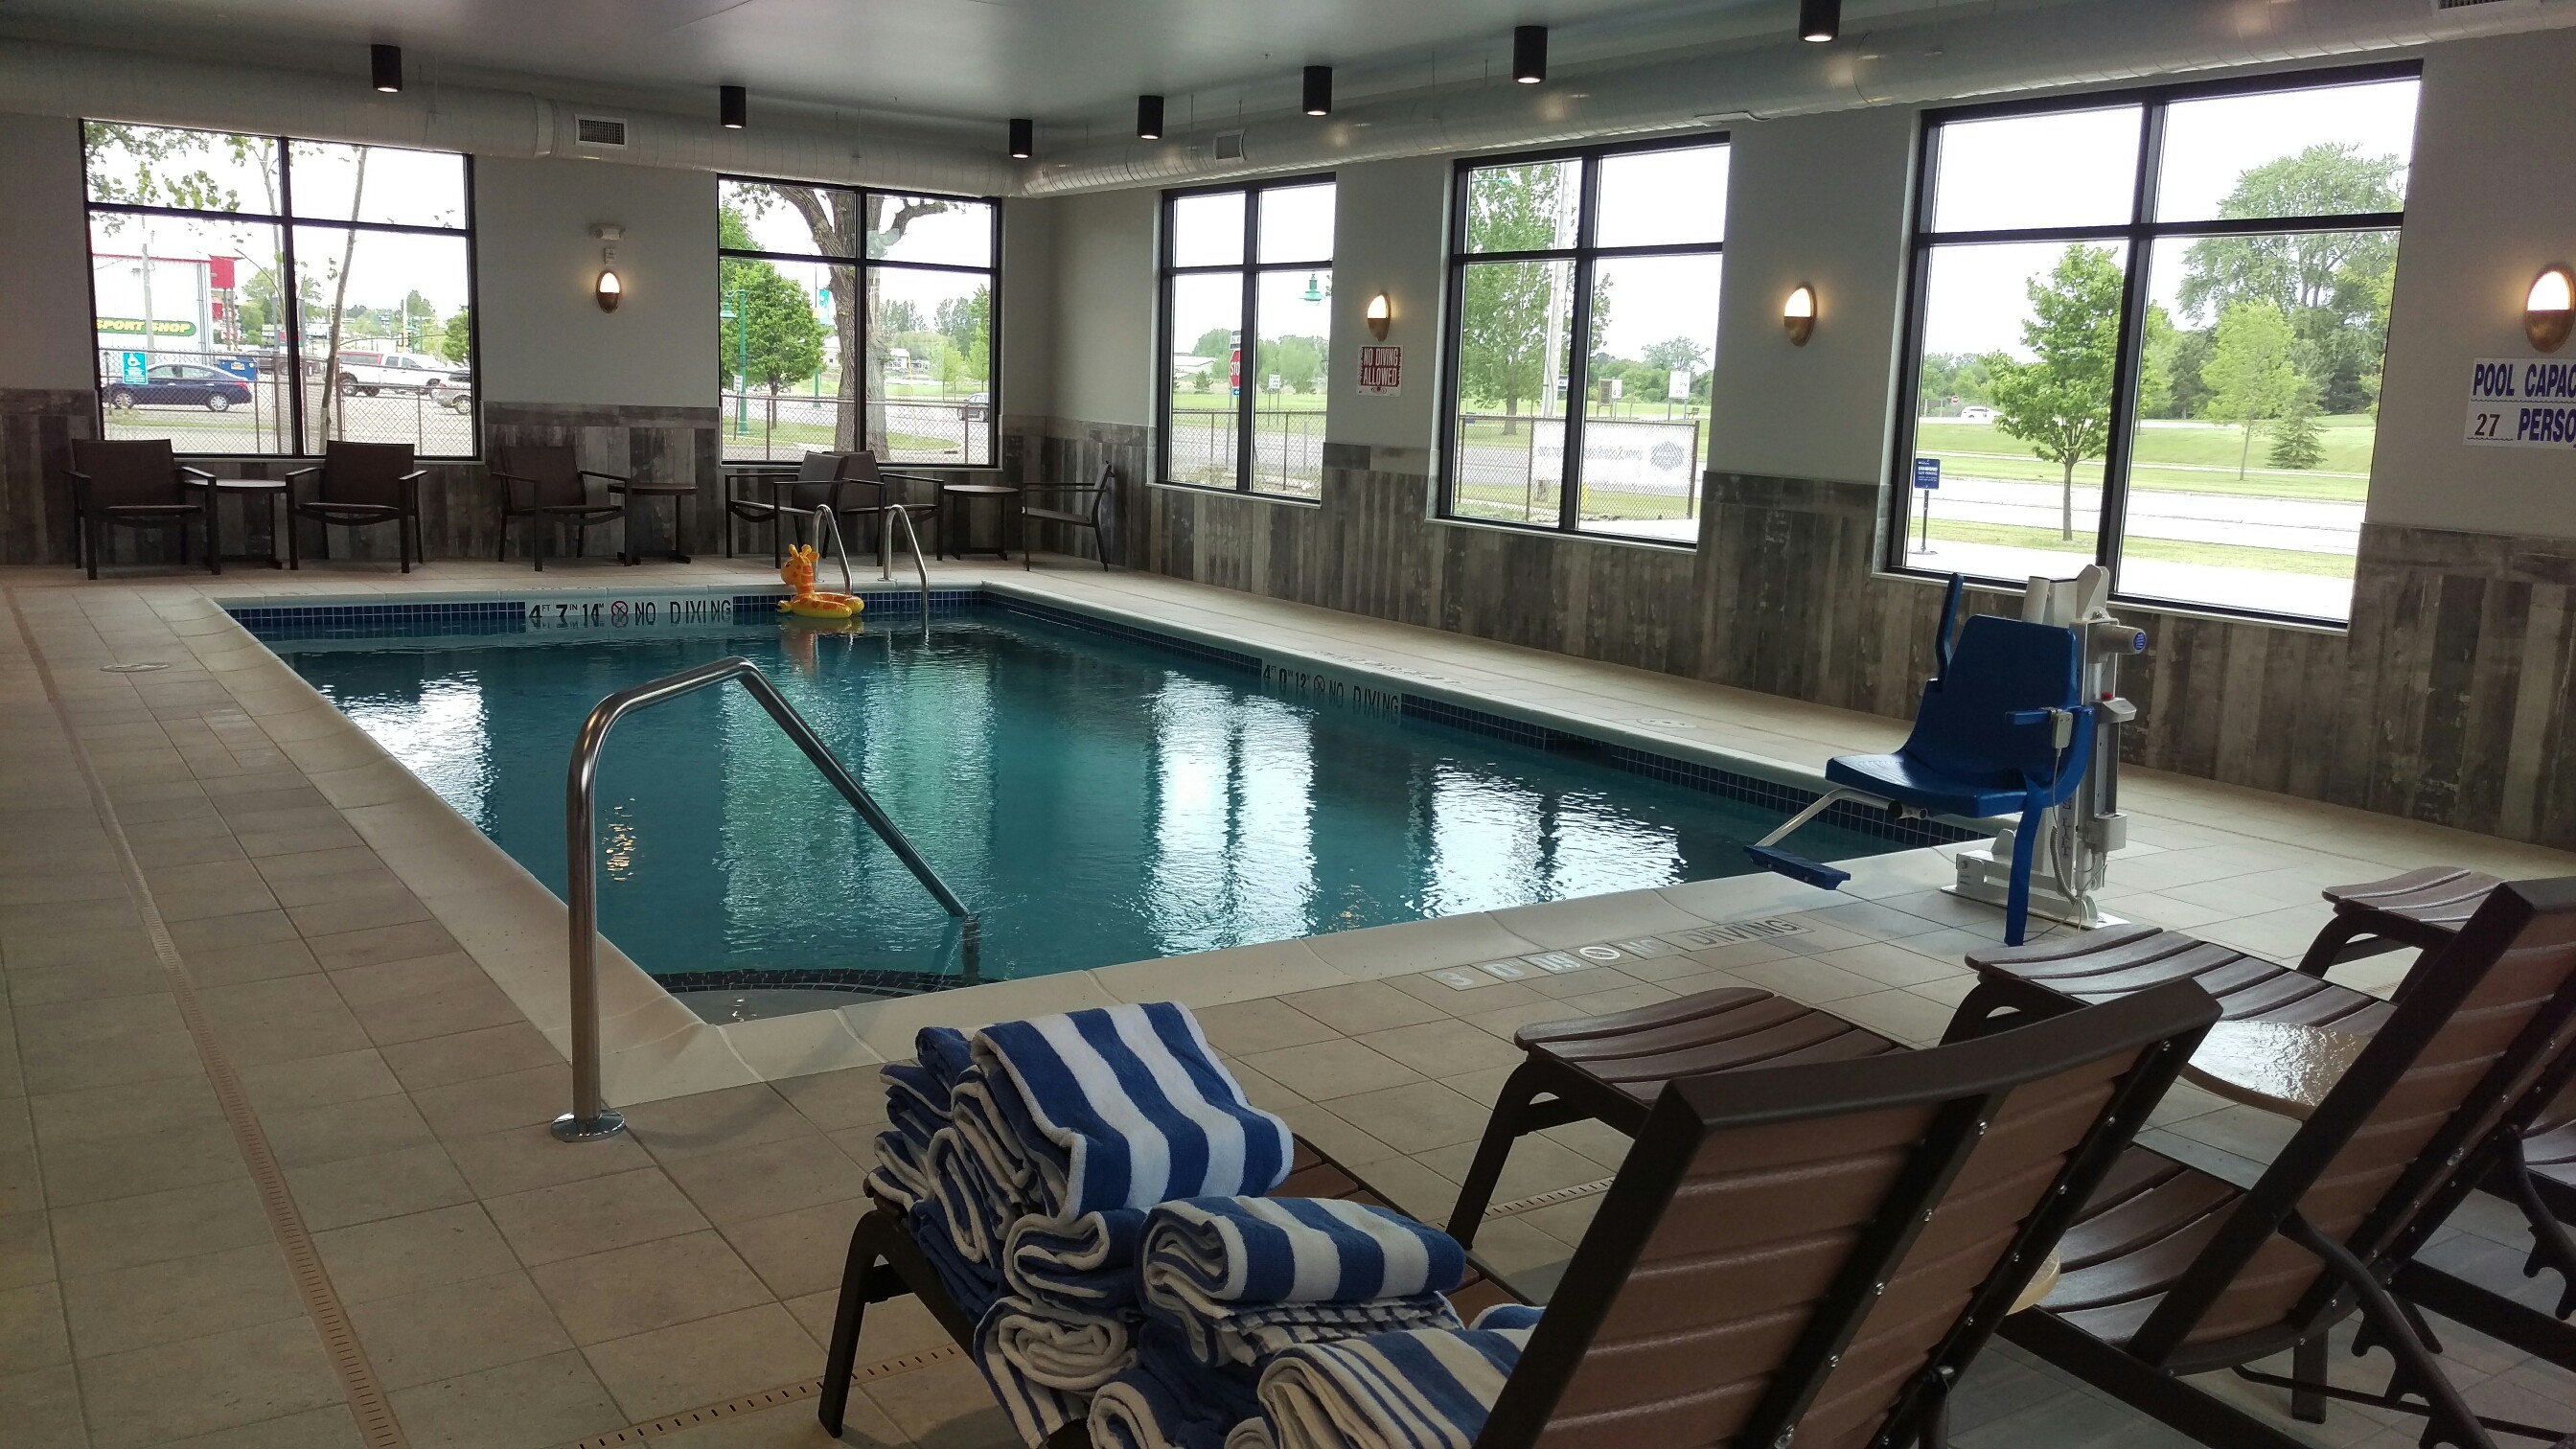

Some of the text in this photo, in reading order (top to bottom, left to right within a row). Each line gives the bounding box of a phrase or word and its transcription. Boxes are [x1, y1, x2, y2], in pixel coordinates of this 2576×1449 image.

[97, 320, 191, 334] SPORT SHOP
[1363, 348, 1398, 367] NO DIVING
[1363, 367, 1397, 386] ALLOWED
[2472, 363, 2515, 397] POOL
[2474, 407, 2576, 443] 27 PERSO
[634, 602, 656, 615] NO
[670, 600, 732, 614] DIVING
[1329, 679, 1344, 699] NO
[1353, 685, 1399, 713] DIVING
[1680, 919, 1799, 946] DIVING
